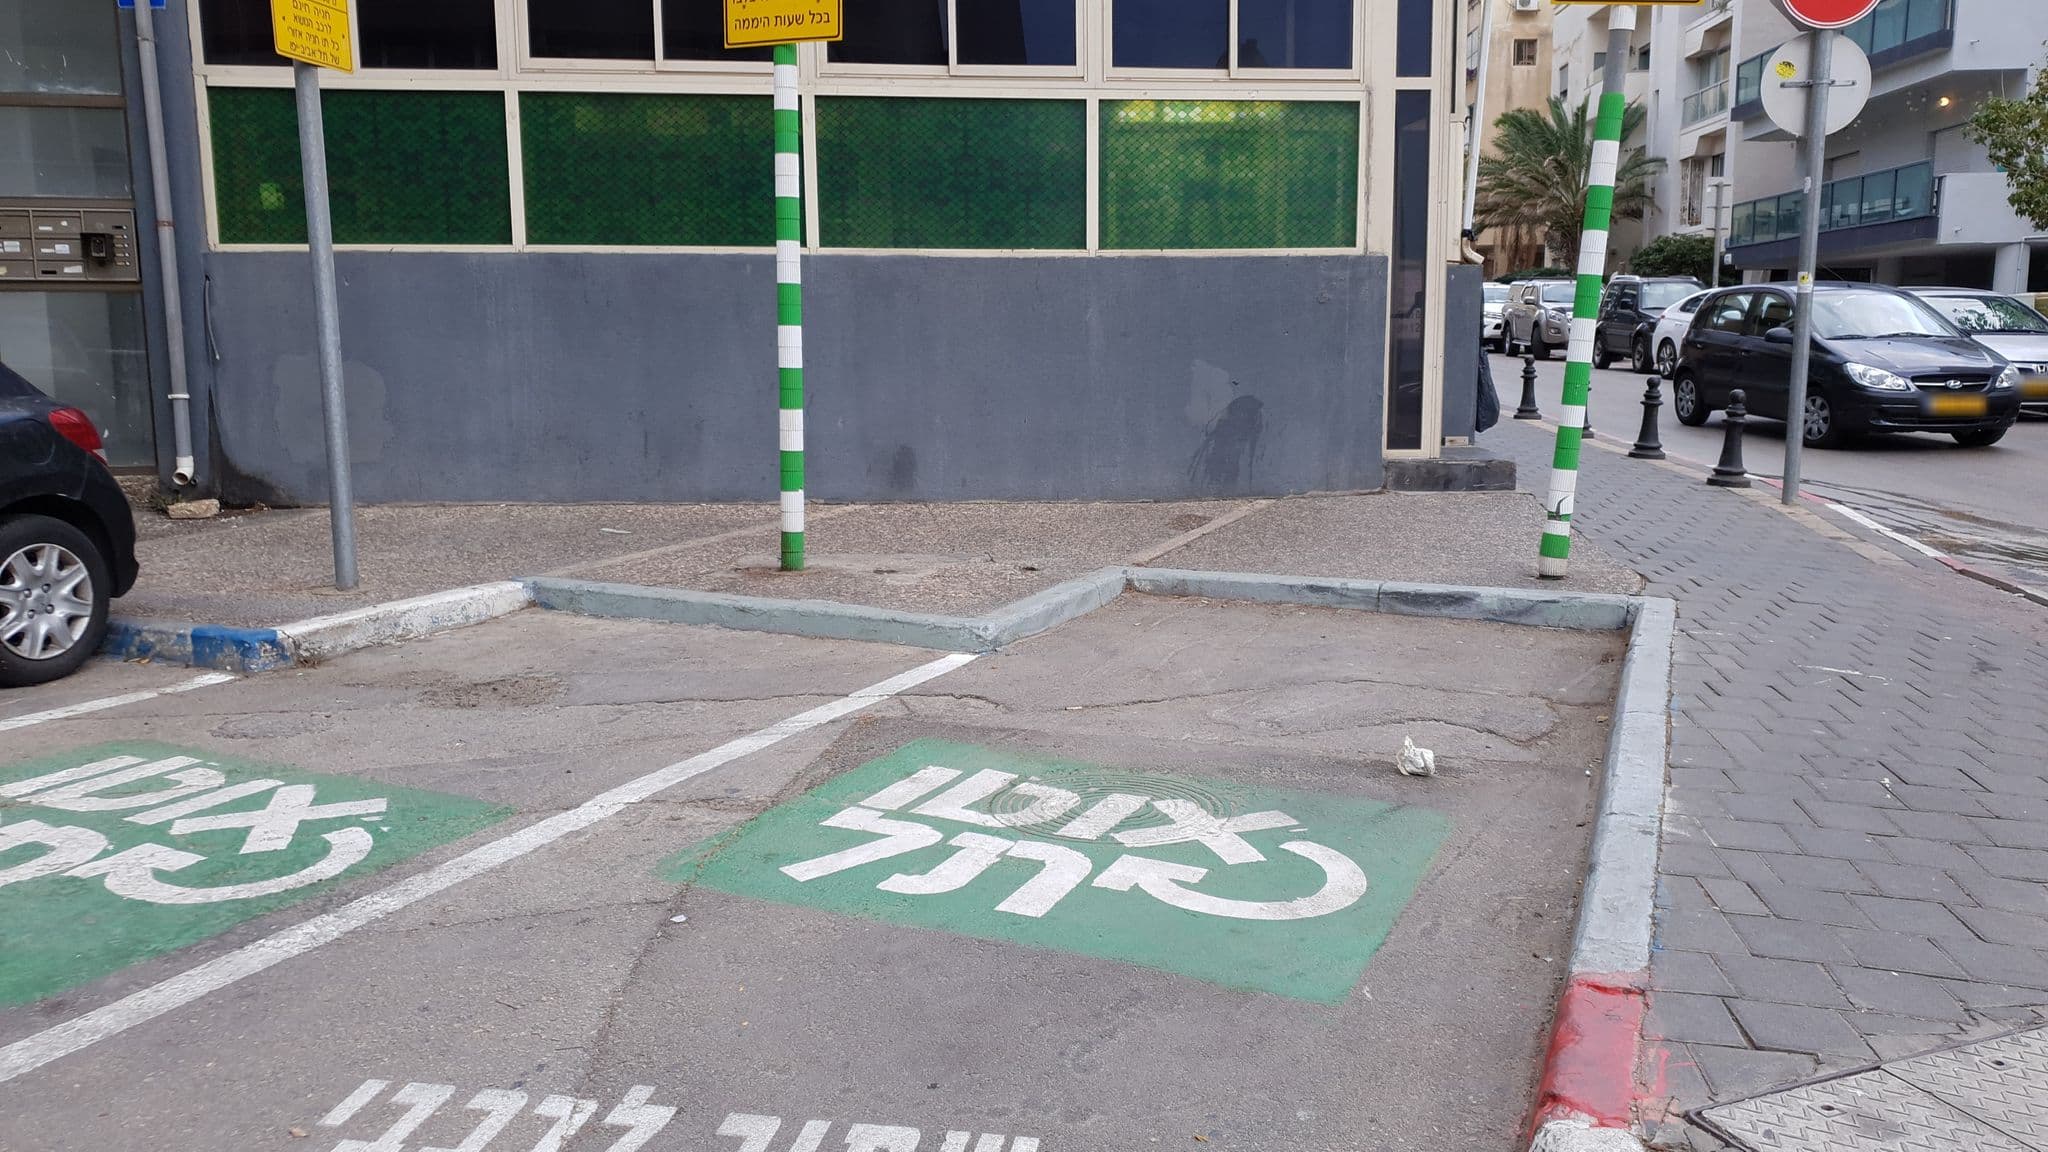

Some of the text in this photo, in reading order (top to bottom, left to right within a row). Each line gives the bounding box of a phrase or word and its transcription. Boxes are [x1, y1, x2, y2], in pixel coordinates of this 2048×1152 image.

[734, 9, 831, 30] בכל שעות היממה
[780, 805, 1094, 918] תל
[858, 765, 1300, 865] אוטו
